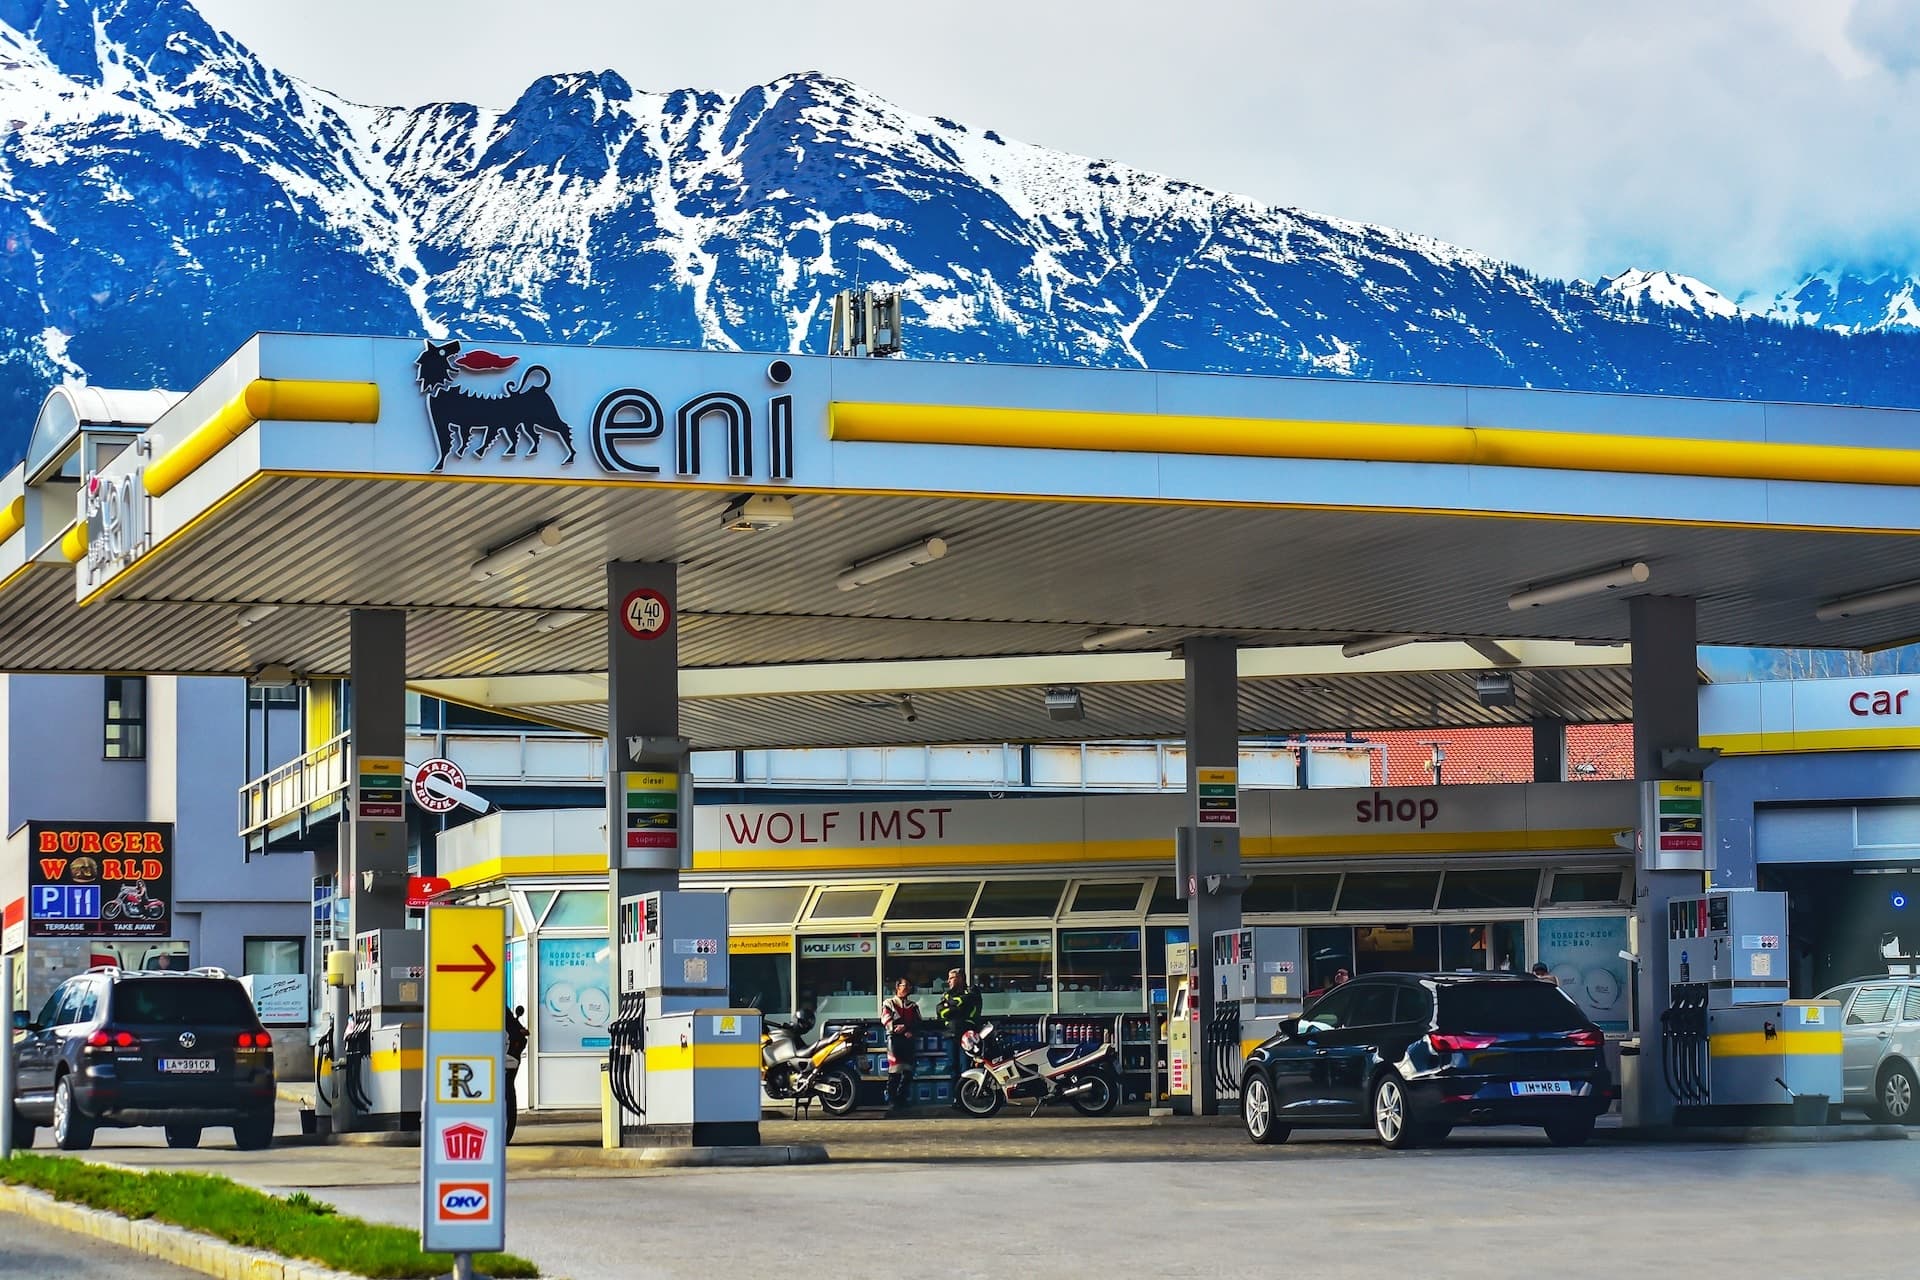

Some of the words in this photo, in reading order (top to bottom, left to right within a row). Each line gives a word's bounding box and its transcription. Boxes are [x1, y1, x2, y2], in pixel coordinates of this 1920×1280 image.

[590, 359, 793, 480] eni
[1849, 689, 1909, 716] car
[423, 763, 462, 784] TABAK
[642, 776, 664, 785] diesel
[416, 781, 453, 809] TRAFIK
[1674, 784, 1692, 792] diesel
[1356, 791, 1438, 829] shop
[725, 811, 840, 845] WOLF
[859, 808, 952, 842] IMST
[39, 831, 164, 854] BURGER
[42, 887, 59, 910] P
[45, 923, 85, 931] TERRASSE
[113, 923, 134, 931] TAKE
[134, 923, 156, 931] AWAY
[804, 943, 831, 953] WOLF
[832, 943, 856, 951] IMST
[1525, 1082, 1535, 1092] IM
[445, 1126, 484, 1159] UTA
[446, 1196, 483, 1208] DKV
